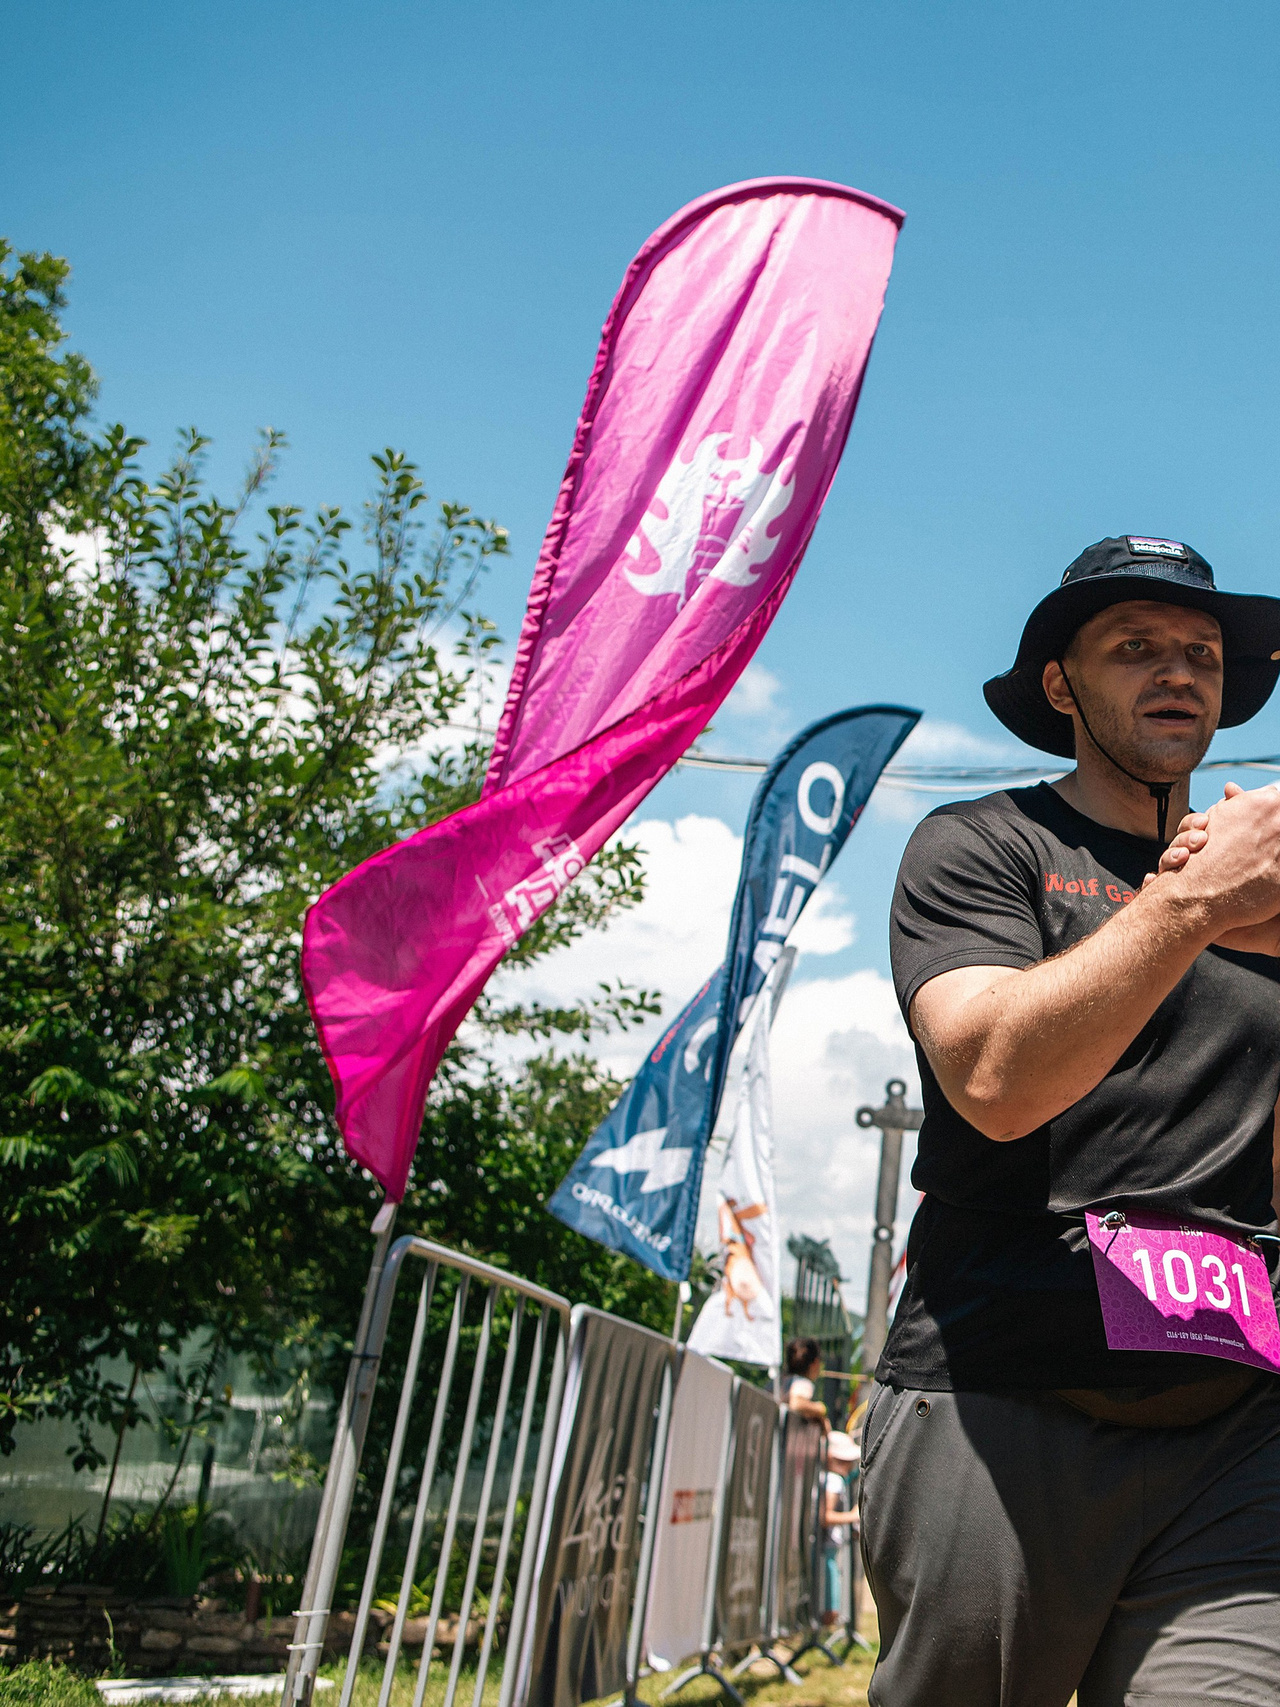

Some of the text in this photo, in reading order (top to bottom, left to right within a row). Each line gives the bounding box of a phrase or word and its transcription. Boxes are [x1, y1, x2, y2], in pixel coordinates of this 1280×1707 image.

[1134, 545, 1183, 556] patagonia
[1044, 871, 1137, 904] Wolf Ga
[1132, 1249, 1251, 1317] 1031
